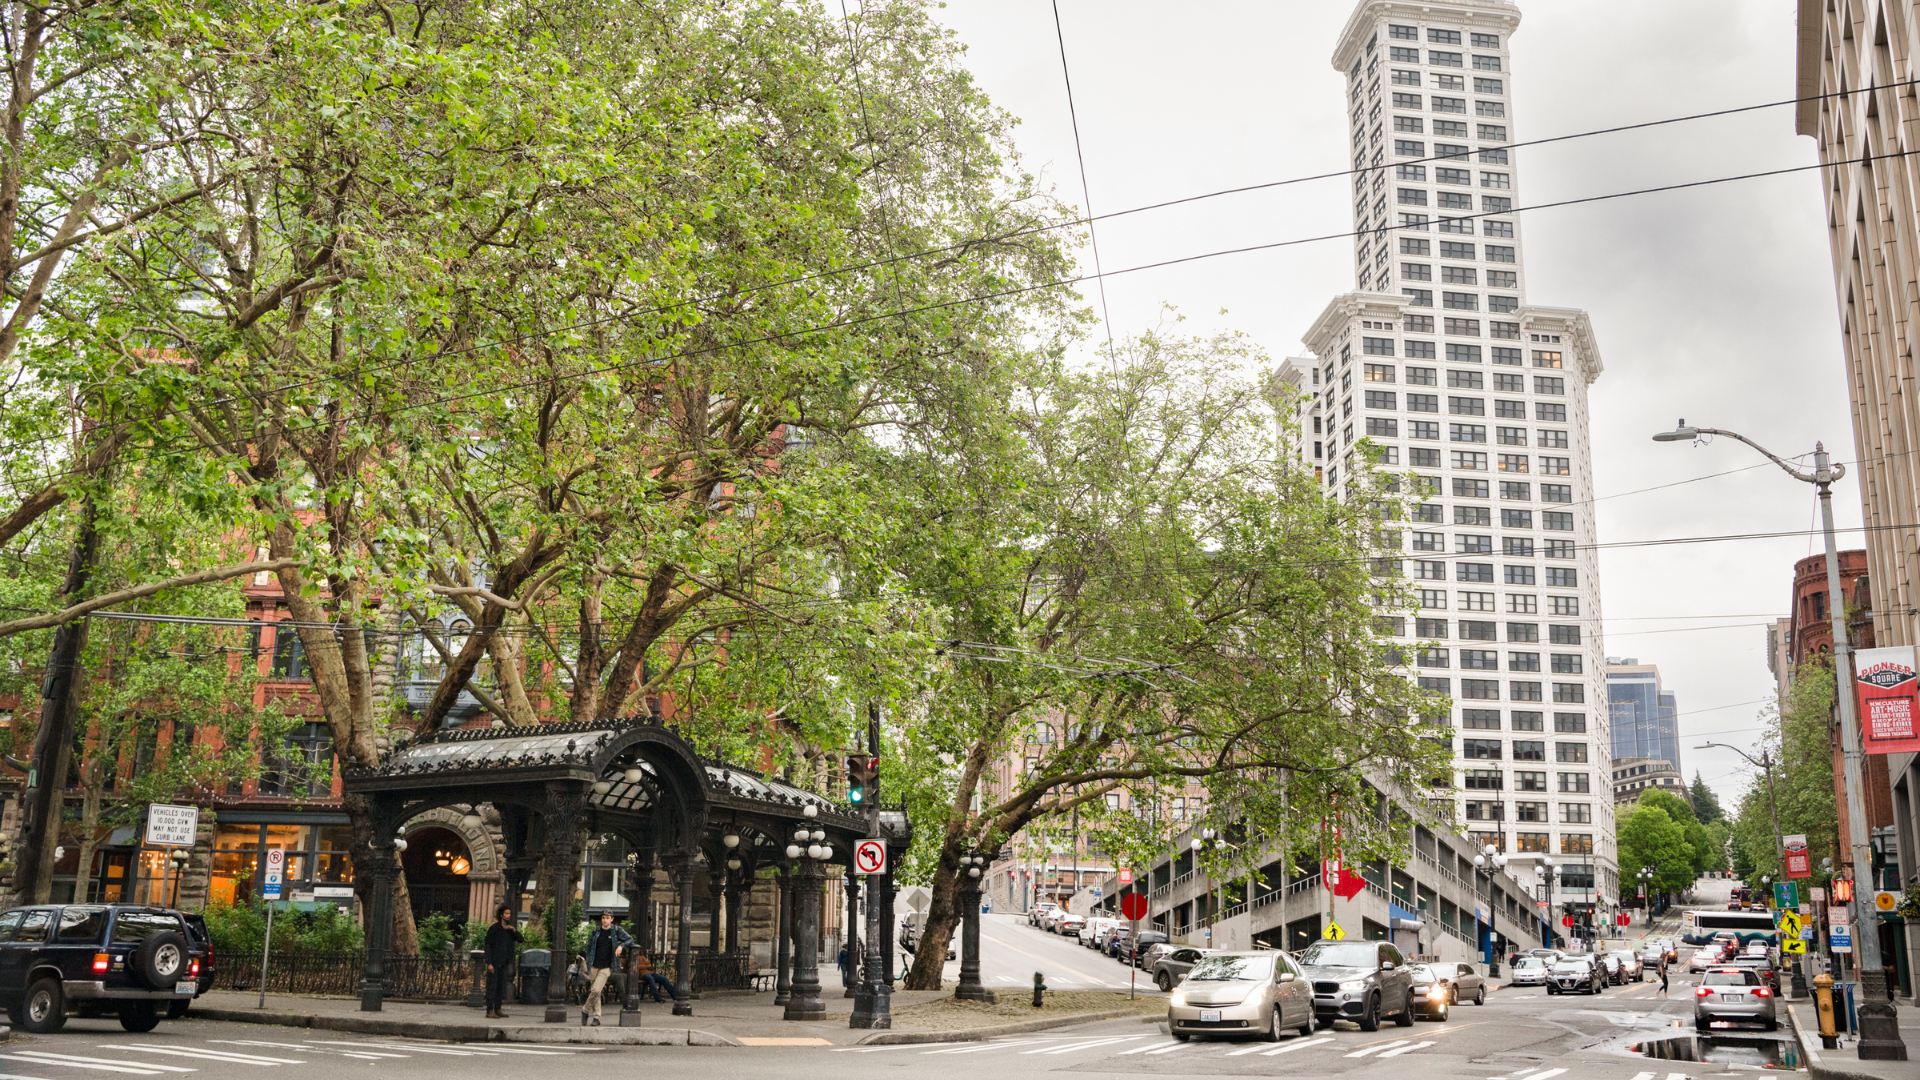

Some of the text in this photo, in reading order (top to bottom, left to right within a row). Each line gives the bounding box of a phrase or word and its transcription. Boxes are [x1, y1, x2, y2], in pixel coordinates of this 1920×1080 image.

[1861, 661, 1912, 679] PIONEER
[1872, 674, 1901, 683] SQUARE
[153, 809, 195, 818] VEHICLES OVER
[157, 817, 175, 825] 10,000
